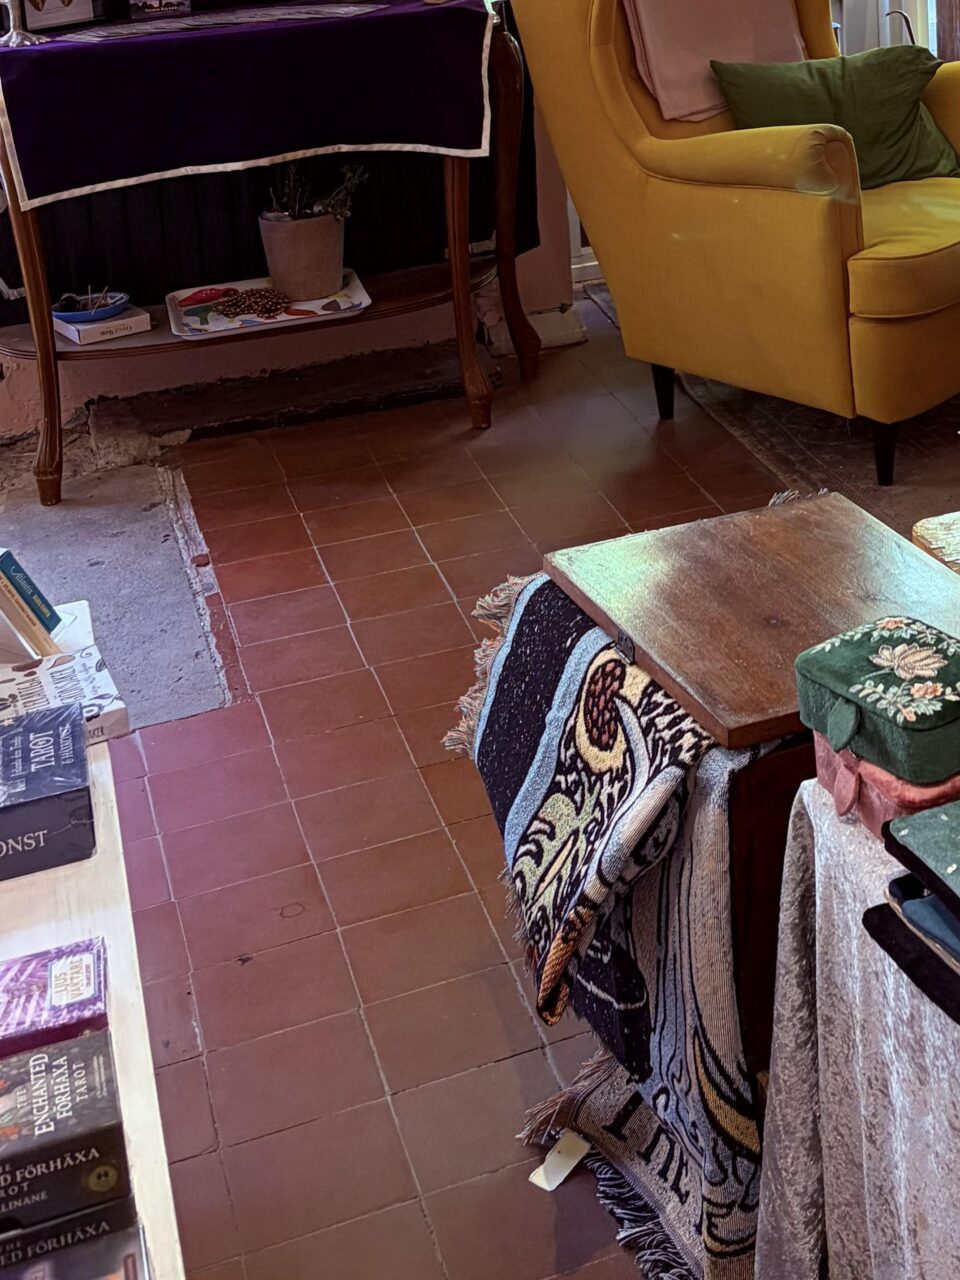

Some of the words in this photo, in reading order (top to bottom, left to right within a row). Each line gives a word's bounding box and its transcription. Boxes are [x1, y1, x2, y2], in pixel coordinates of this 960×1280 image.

[29, 730, 56, 773] TAROT
[30, 1053, 55, 1137] ENCHANTED
[51, 1056, 73, 1121] FÖRHÄXA
[72, 1061, 88, 1102] TAROT
[16, 1147, 100, 1183] FÖRHÄXA
[26, 1221, 110, 1257] FÖRHÄXA
